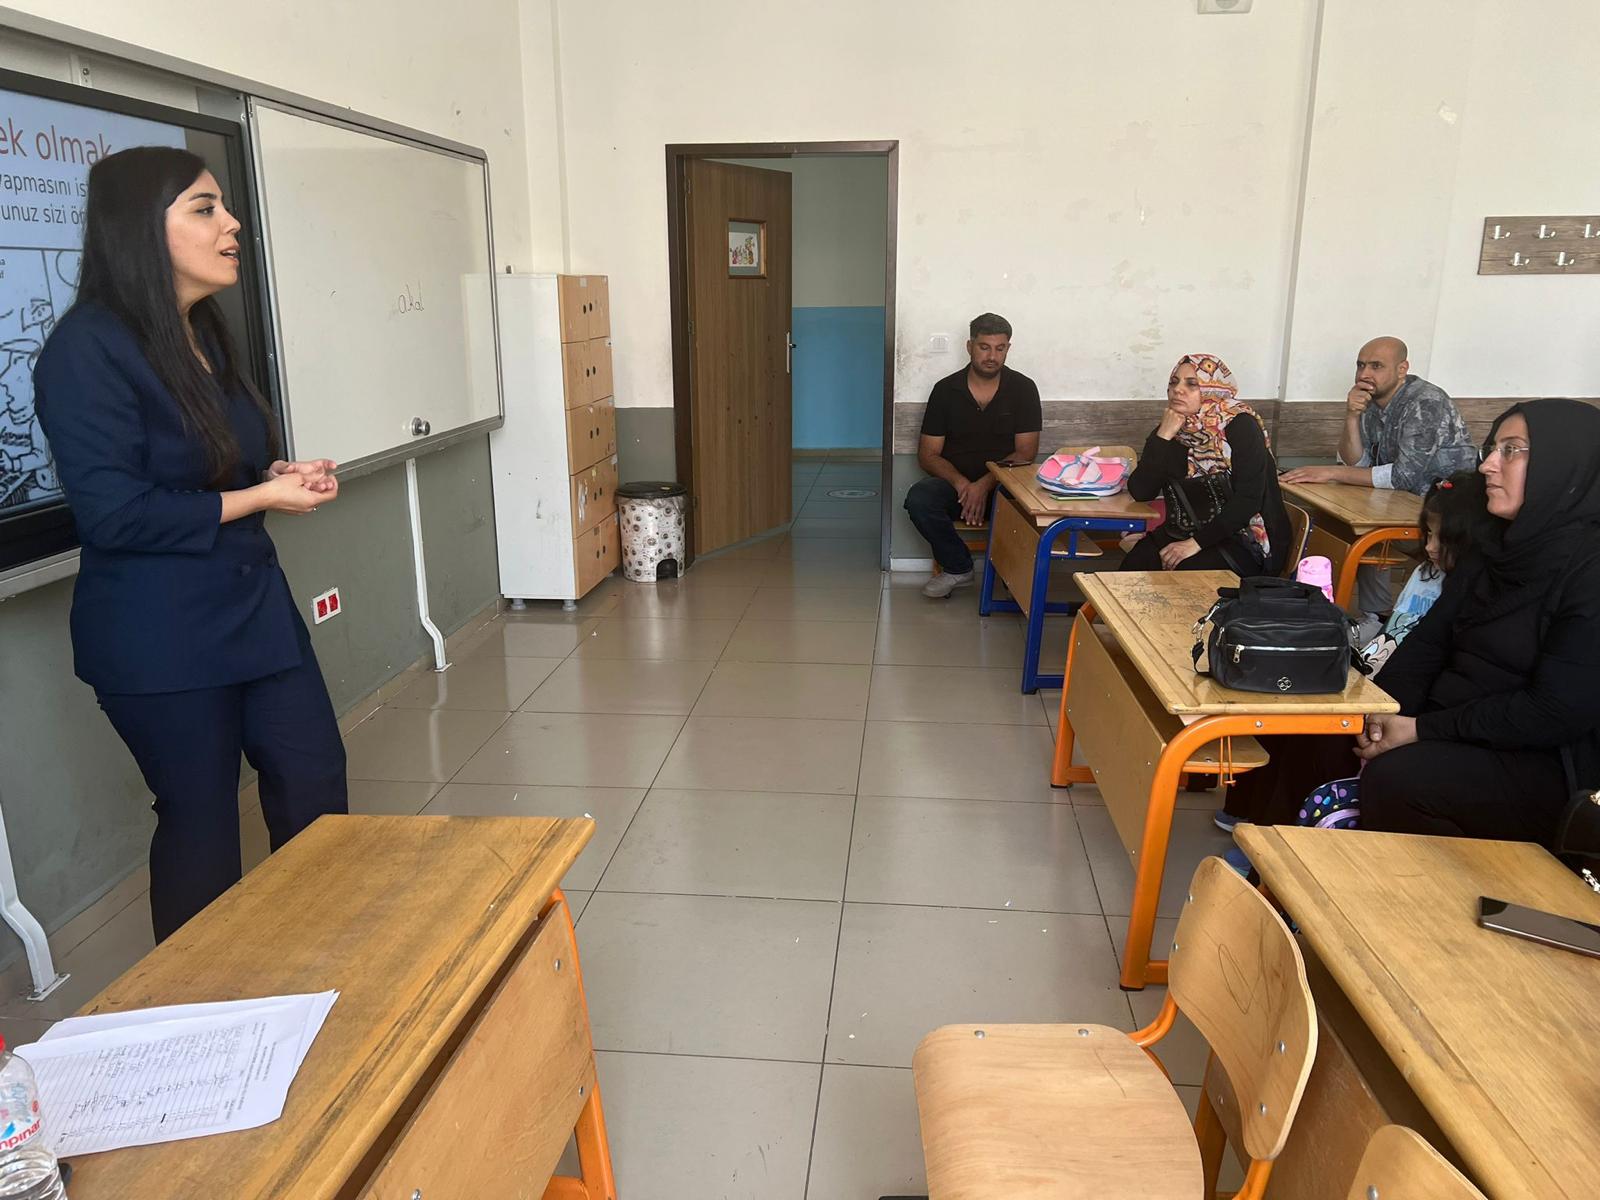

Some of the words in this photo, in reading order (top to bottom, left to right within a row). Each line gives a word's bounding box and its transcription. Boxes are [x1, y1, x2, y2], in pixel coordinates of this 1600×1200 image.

[36, 124, 112, 167] olmak
[0, 173, 71, 196] apmasını
[43, 203, 67, 225] sizi
